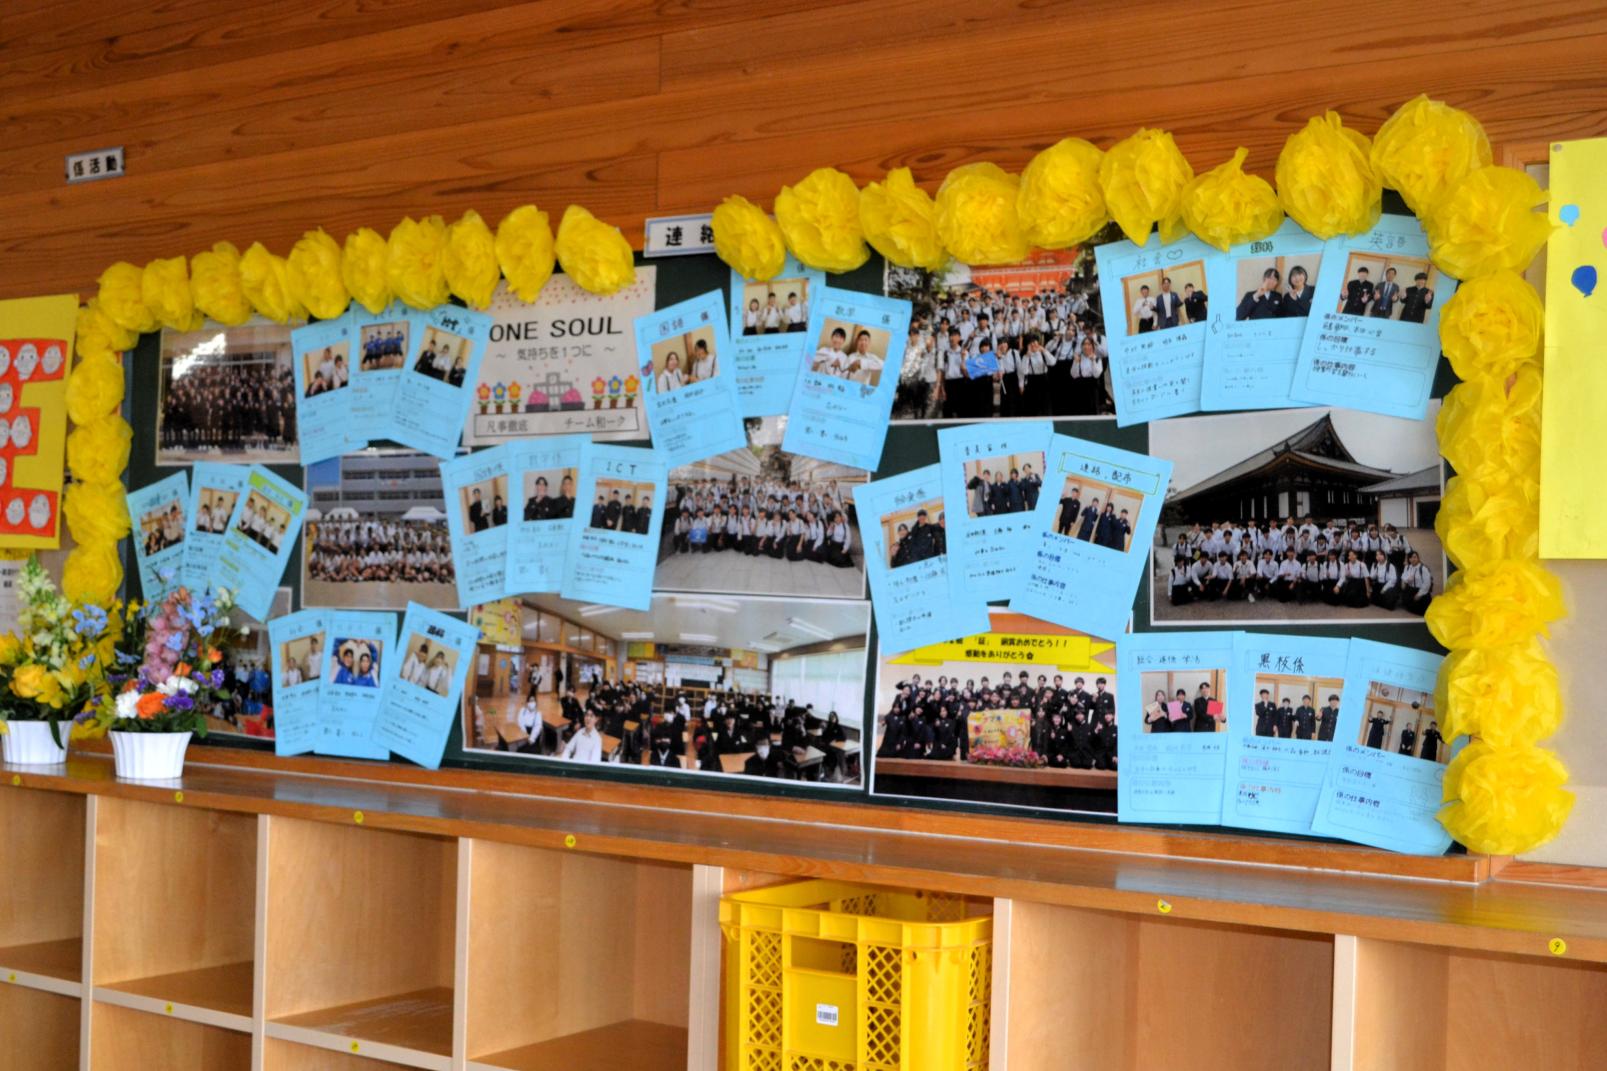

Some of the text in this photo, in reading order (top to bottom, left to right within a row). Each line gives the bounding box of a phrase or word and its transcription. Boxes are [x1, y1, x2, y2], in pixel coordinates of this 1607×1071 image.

[73, 155, 117, 177] 係活動
[489, 321, 539, 342] ONE
[550, 316, 623, 338] SOUL
[487, 420, 528, 432] 凡事徹底
[606, 461, 637, 475] ICT
